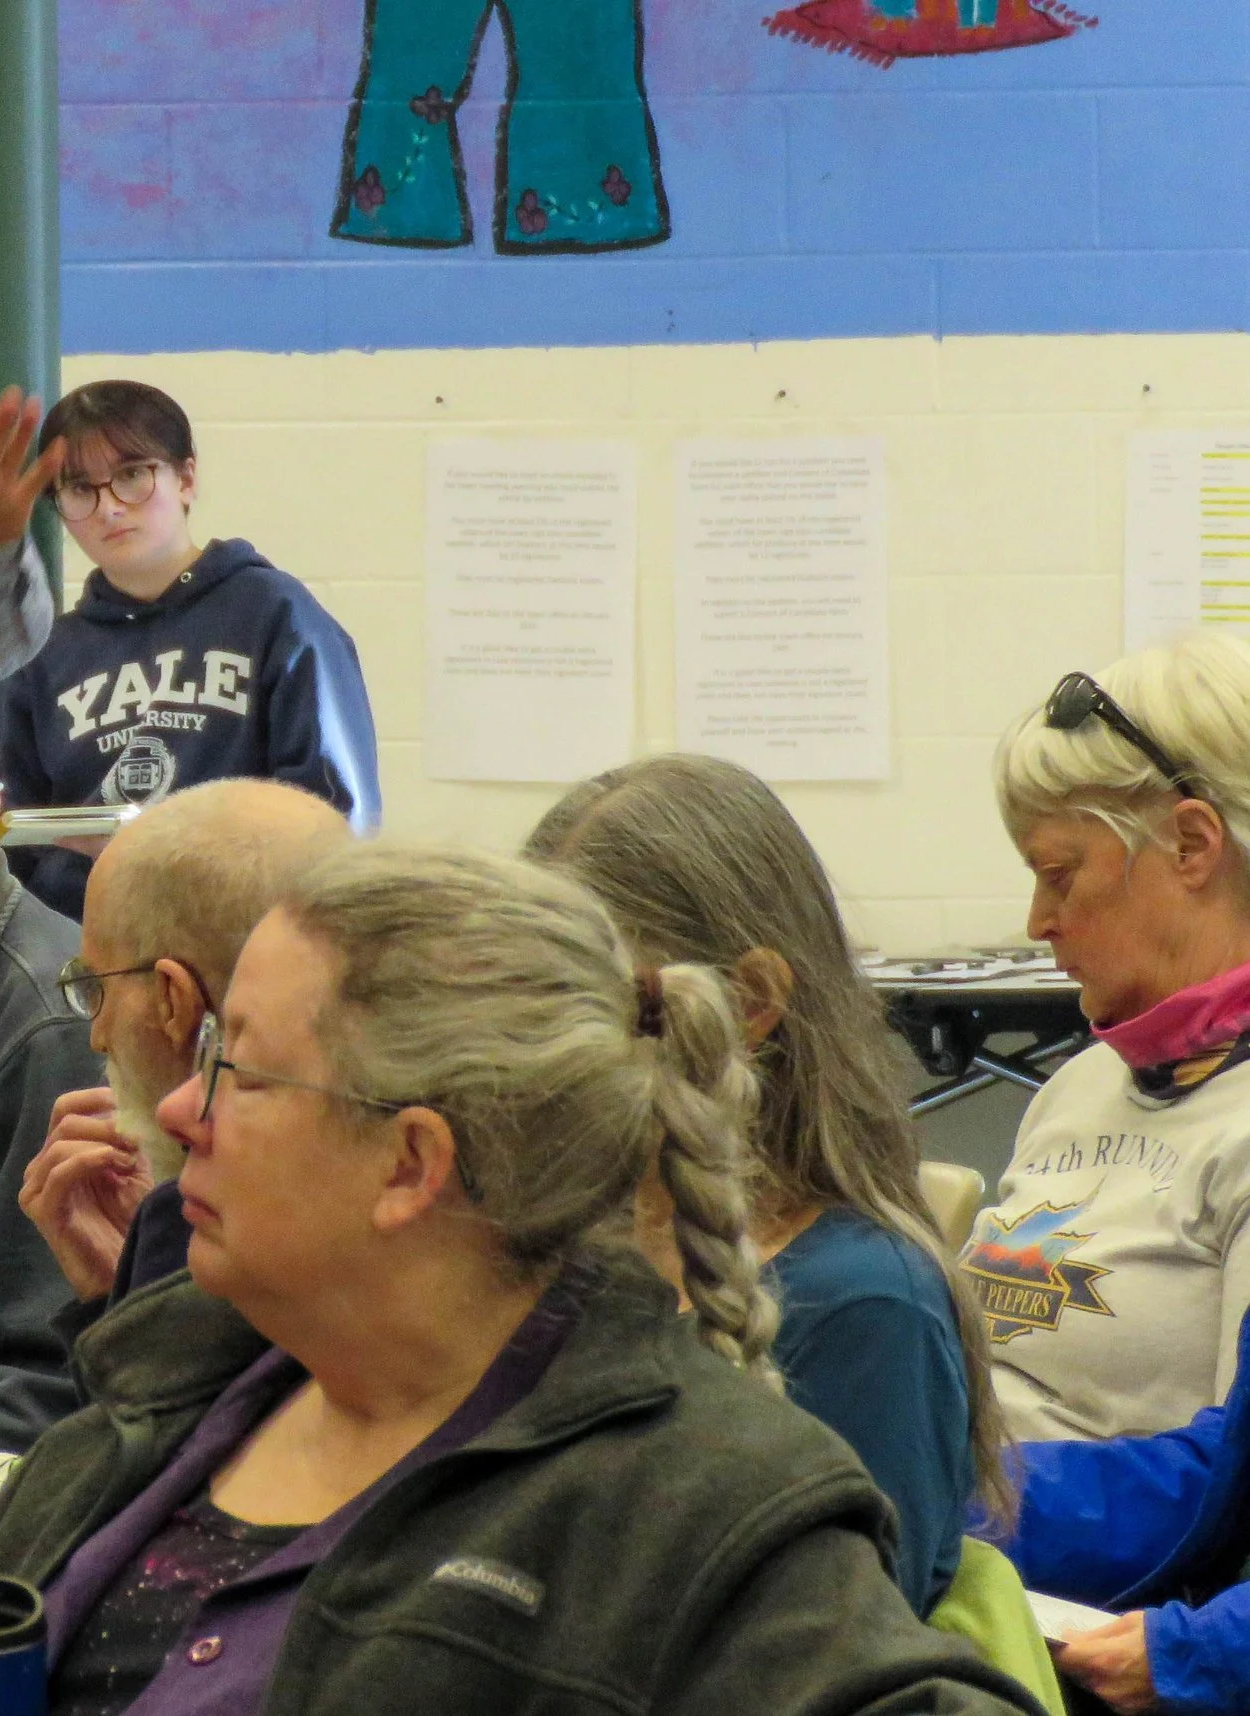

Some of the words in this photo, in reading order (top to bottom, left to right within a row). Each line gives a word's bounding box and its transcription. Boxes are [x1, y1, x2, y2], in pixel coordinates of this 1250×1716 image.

[57, 650, 251, 741] YALE
[96, 710, 207, 753] UNIRSITY
[986, 1283, 1051, 1318] PEEPERS
